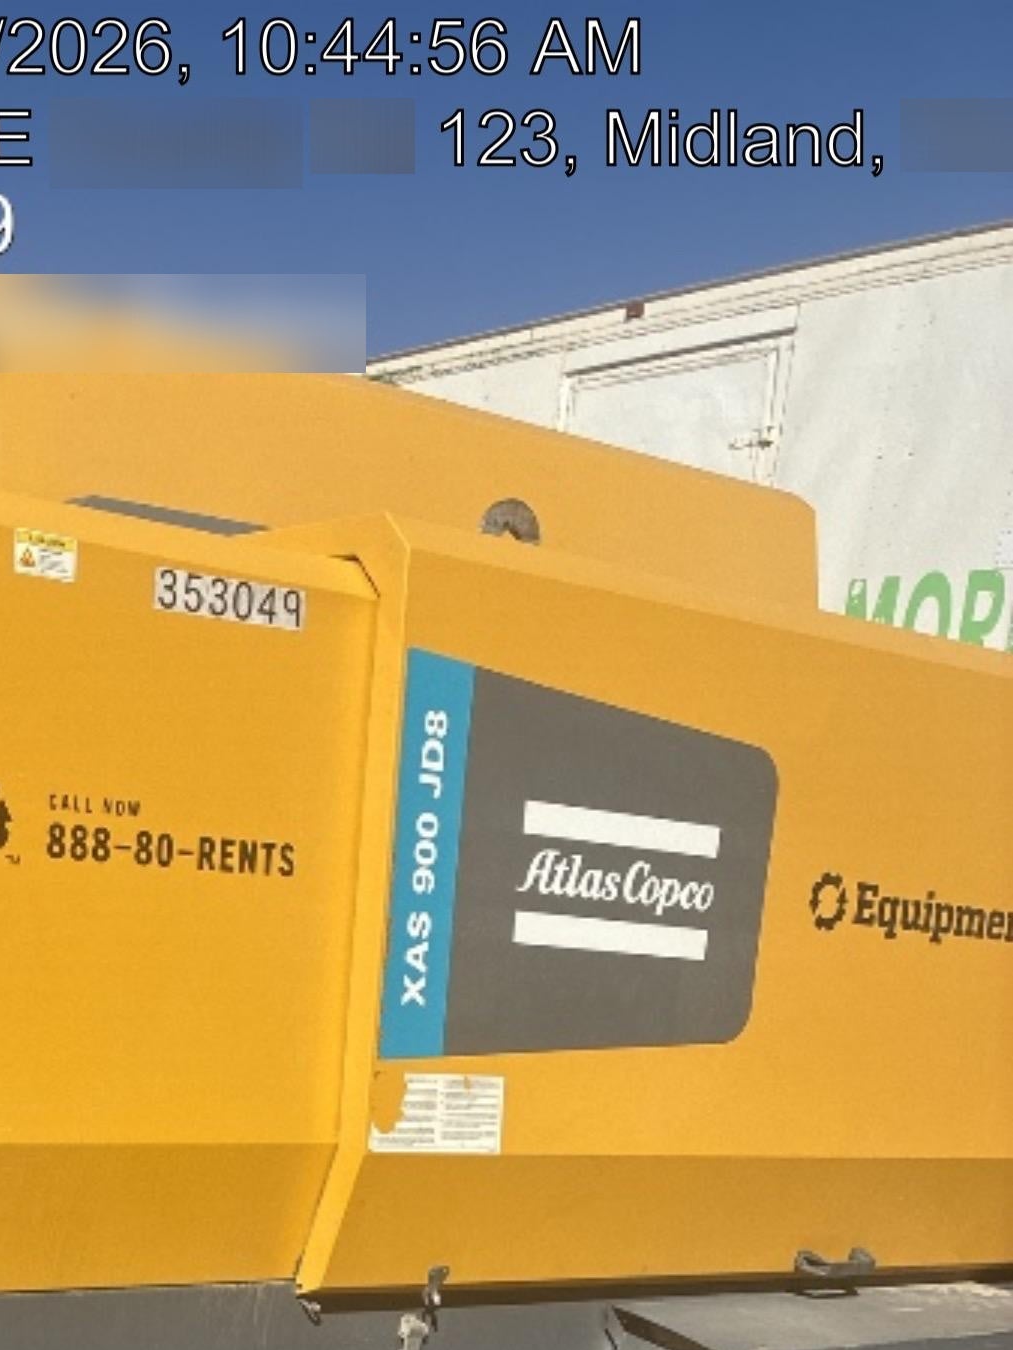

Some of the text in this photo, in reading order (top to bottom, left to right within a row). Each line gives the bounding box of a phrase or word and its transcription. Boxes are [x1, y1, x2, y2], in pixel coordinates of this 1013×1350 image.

[157, 569, 301, 627] 353049
[48, 793, 142, 817] CALL NOW
[46, 821, 296, 877] 888-80-RENTS
[401, 709, 449, 1006] XAS 900 JD8
[515, 848, 715, 916] Atlas Copco
